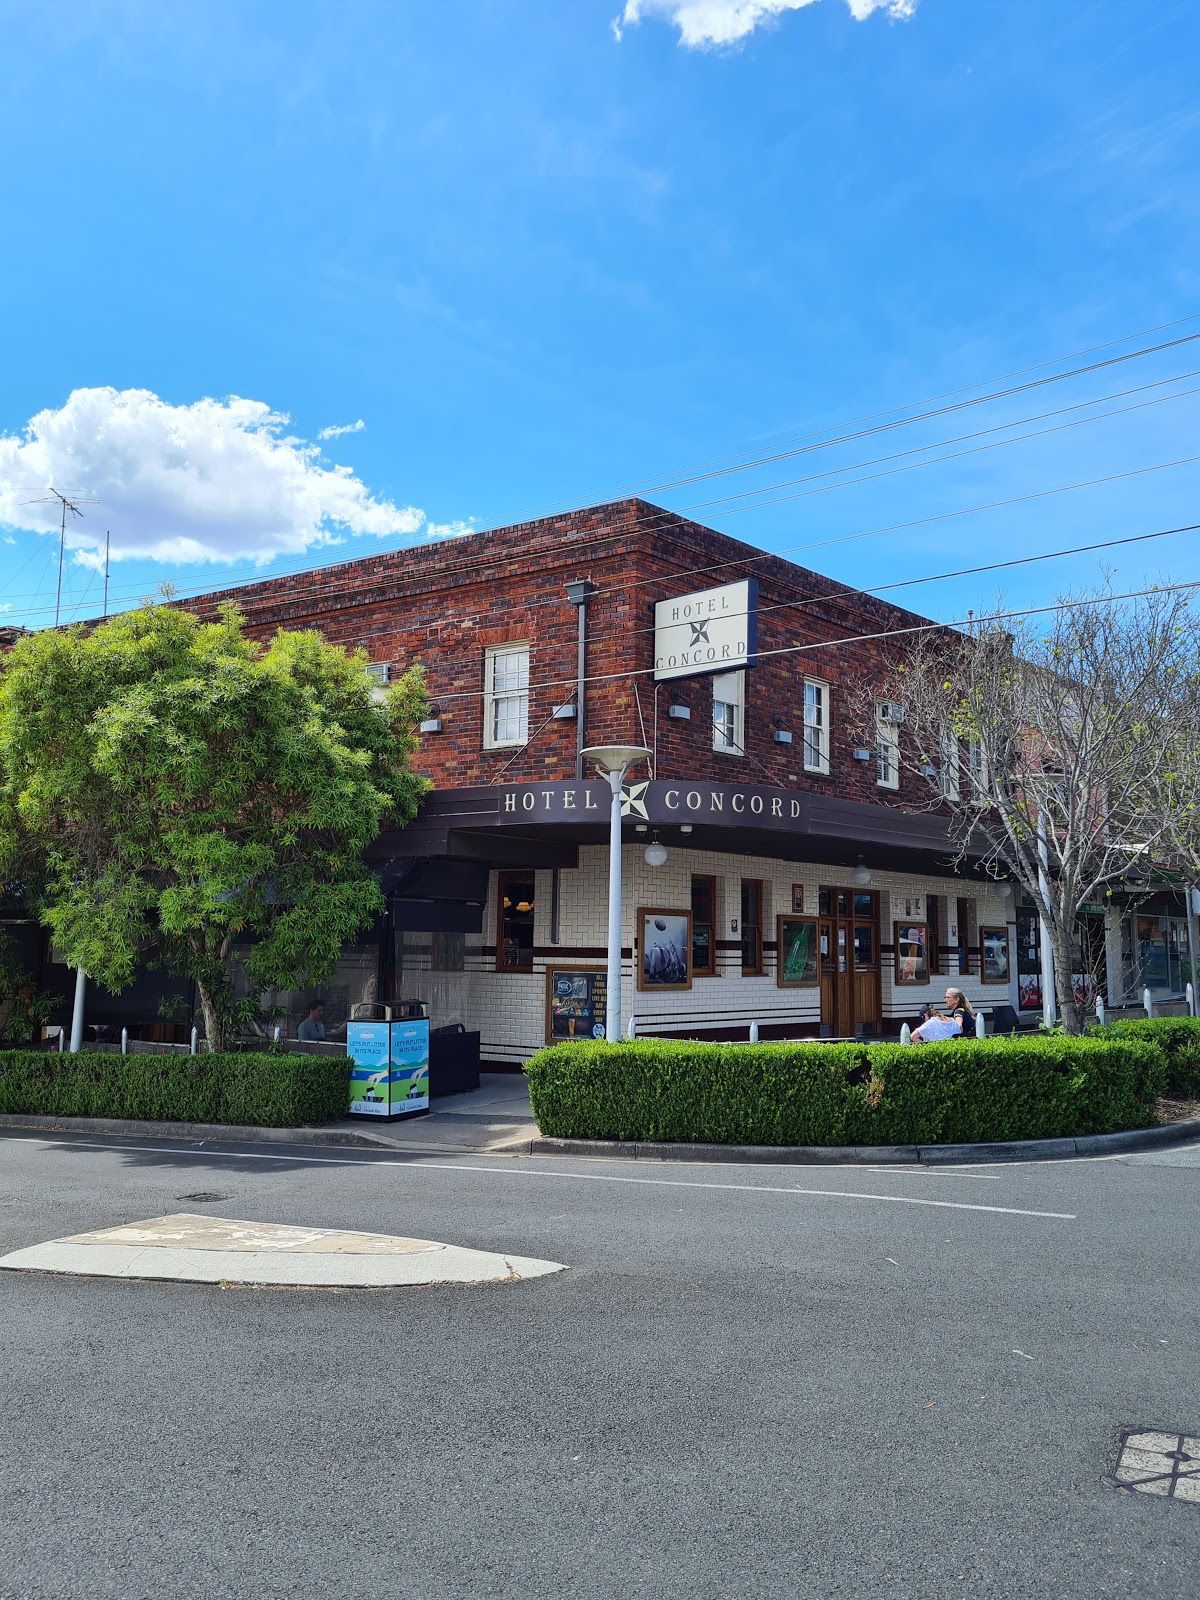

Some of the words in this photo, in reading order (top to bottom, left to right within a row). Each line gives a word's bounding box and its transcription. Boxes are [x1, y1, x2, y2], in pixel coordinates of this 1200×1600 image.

[672, 597, 729, 620] HOTEL
[656, 641, 746, 669] CONCORD
[504, 790, 599, 813] HOTEL
[664, 789, 801, 818] CONCORD
